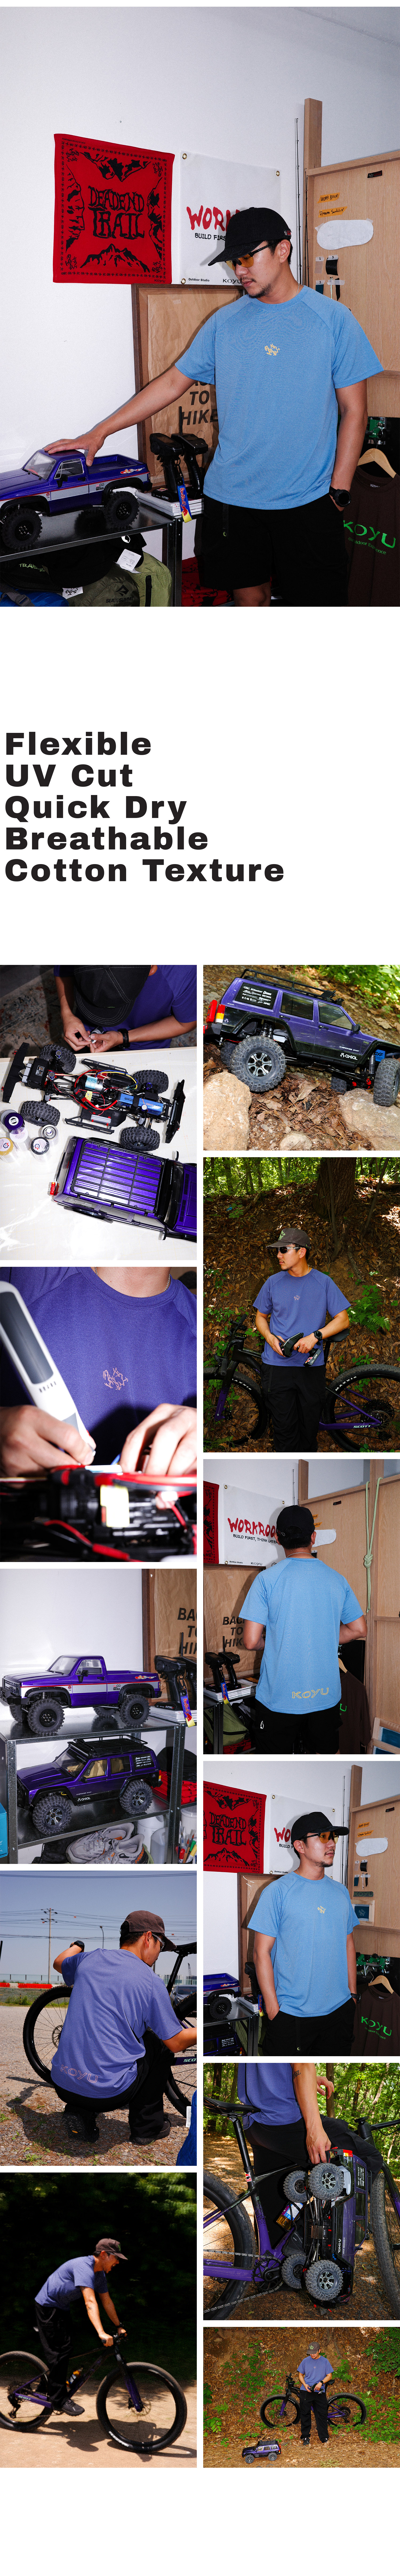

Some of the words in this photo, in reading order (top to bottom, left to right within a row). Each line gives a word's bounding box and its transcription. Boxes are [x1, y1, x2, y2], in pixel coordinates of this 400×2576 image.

[88, 186, 144, 213] DEADEND
[88, 207, 145, 240] TRAIL
[190, 390, 210, 405] TO
[182, 409, 218, 425] HIKE
[343, 520, 396, 548] KOYU
[335, 1376, 357, 1391] MAXXIS
[228, 1517, 277, 1538] WORKROO
[178, 1608, 197, 1621] BA
[188, 1626, 197, 1638] T
[231, 1627, 243, 1635] TO
[225, 1638, 243, 1648] HIK
[292, 1688, 329, 1698] KOYU
[209, 1812, 246, 1830] DEADEND
[209, 1824, 246, 1846] TRAIL
[361, 2016, 392, 2036] KOYU
[61, 2064, 98, 2083] KOYU
